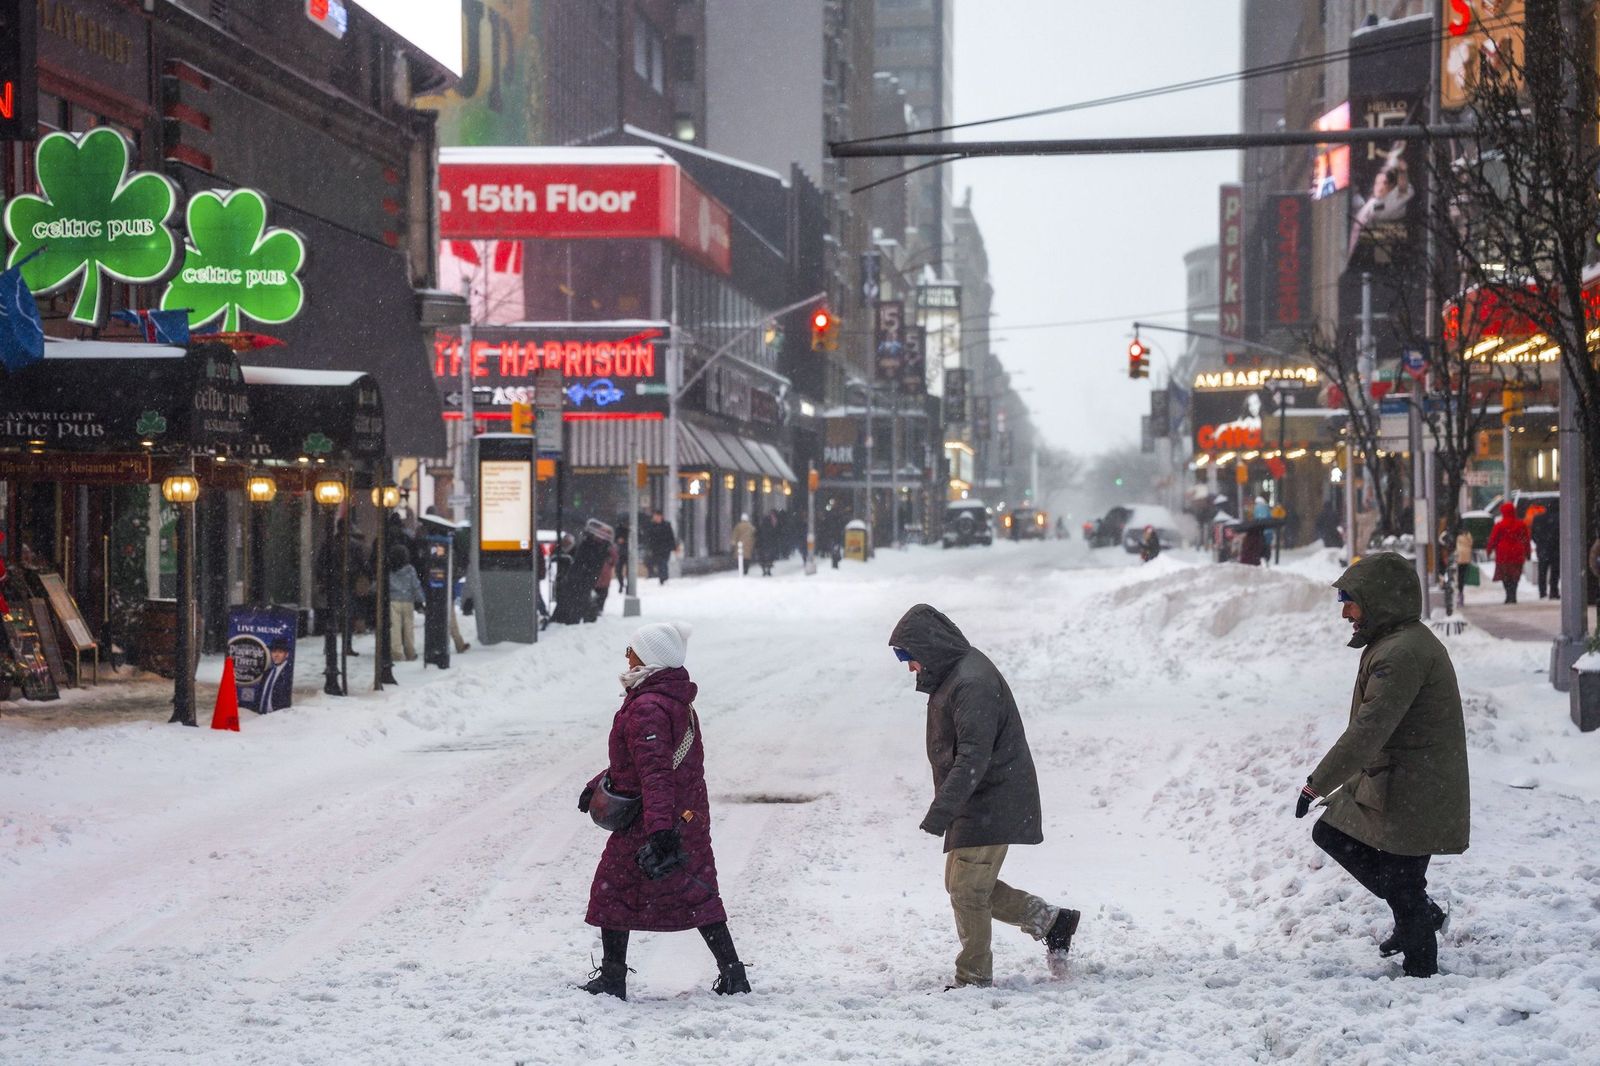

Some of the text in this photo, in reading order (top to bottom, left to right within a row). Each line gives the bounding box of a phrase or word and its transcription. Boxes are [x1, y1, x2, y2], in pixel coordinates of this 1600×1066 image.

[462, 184, 537, 213] 15th
[546, 184, 637, 213] Floor
[501, 341, 655, 377] HARRISON
[0, 412, 95, 421] AYWRIGHT
[237, 624, 283, 635] LIVE MUSIC
